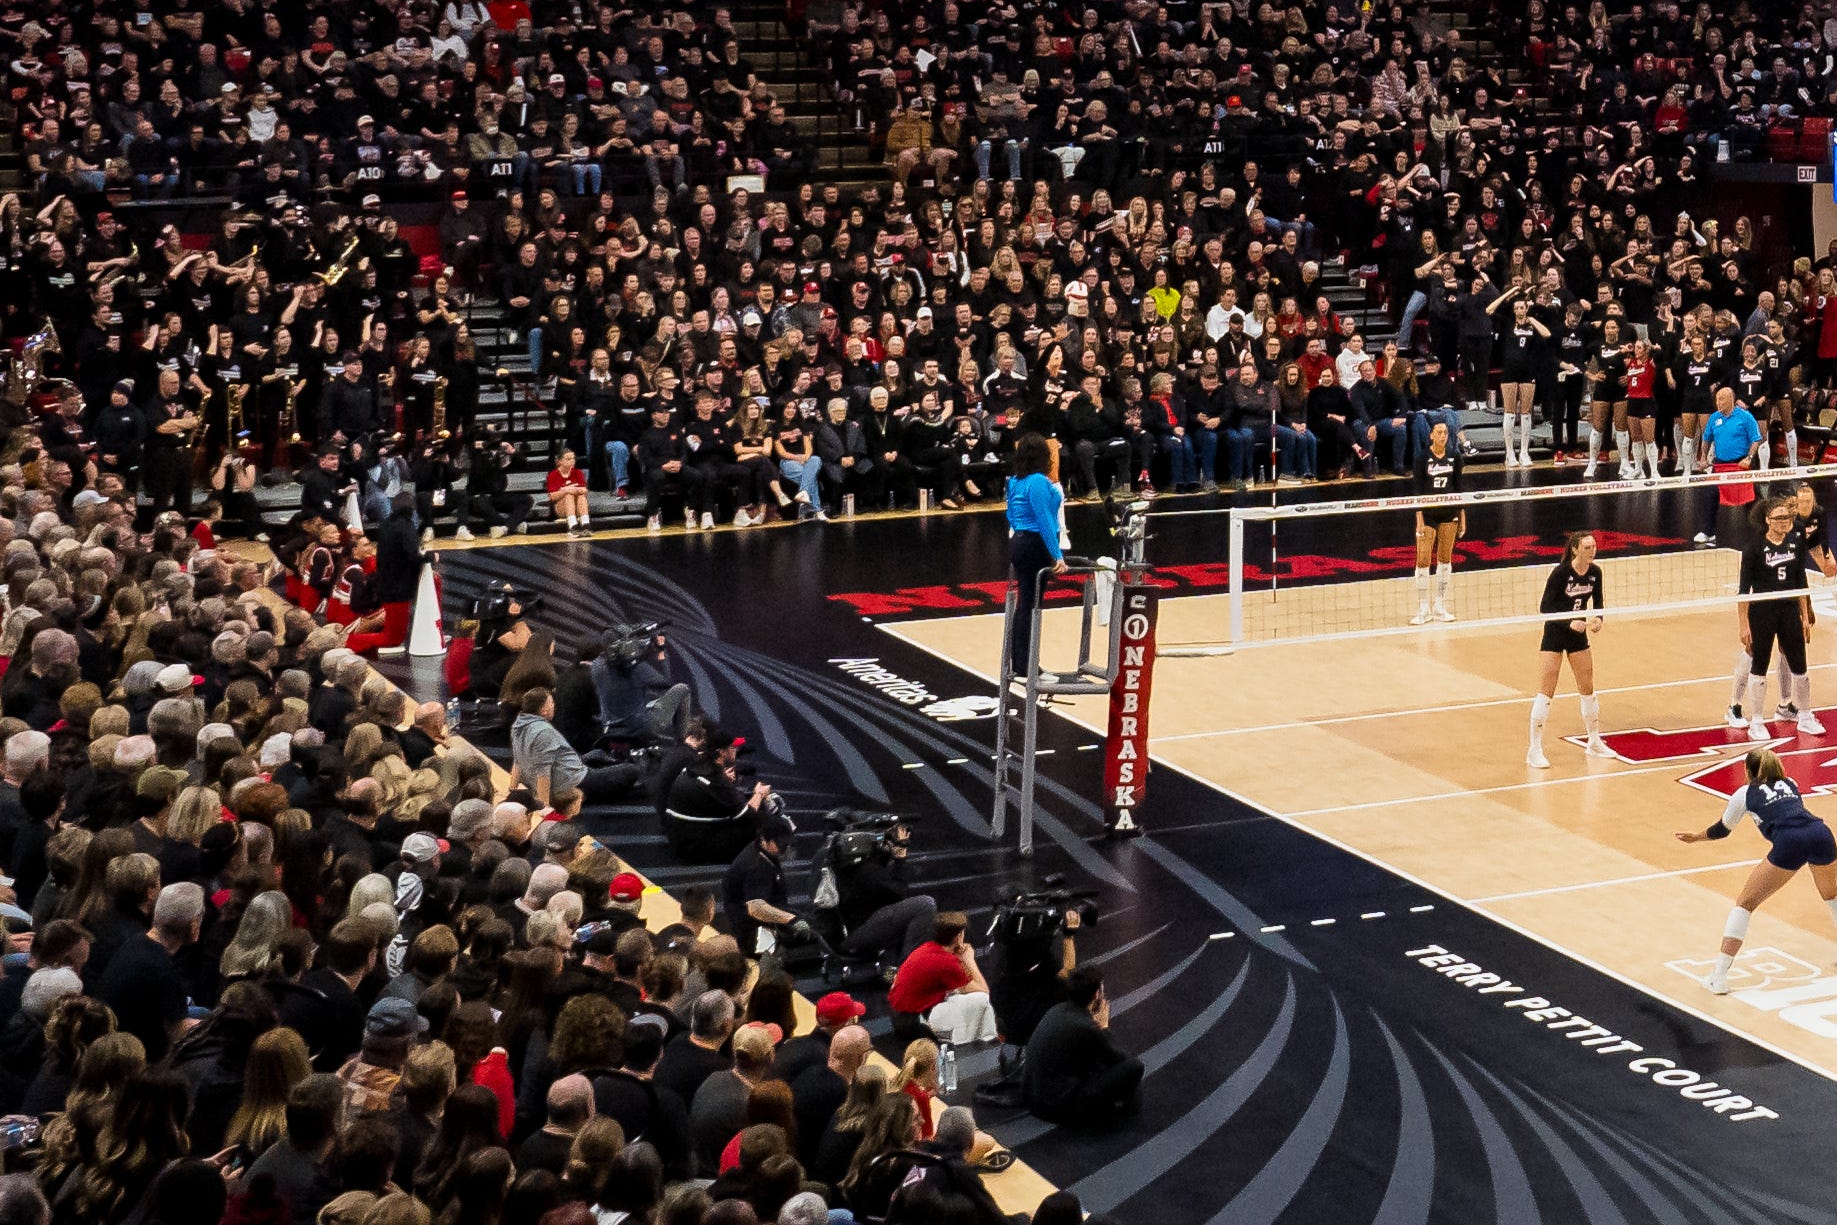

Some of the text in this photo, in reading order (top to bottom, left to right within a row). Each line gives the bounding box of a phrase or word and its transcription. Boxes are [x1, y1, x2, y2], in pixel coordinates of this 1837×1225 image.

[491, 163, 513, 176] A11
[1800, 168, 1816, 180] EXIT
[1433, 477, 1447, 488] 27
[1778, 566, 1787, 580] 5
[827, 657, 938, 706] Ameritas
[1114, 646, 1144, 832] NEBRASKA
[1759, 780, 1793, 801] 14
[1405, 944, 1780, 1123] TERRY PETTIT COURT
